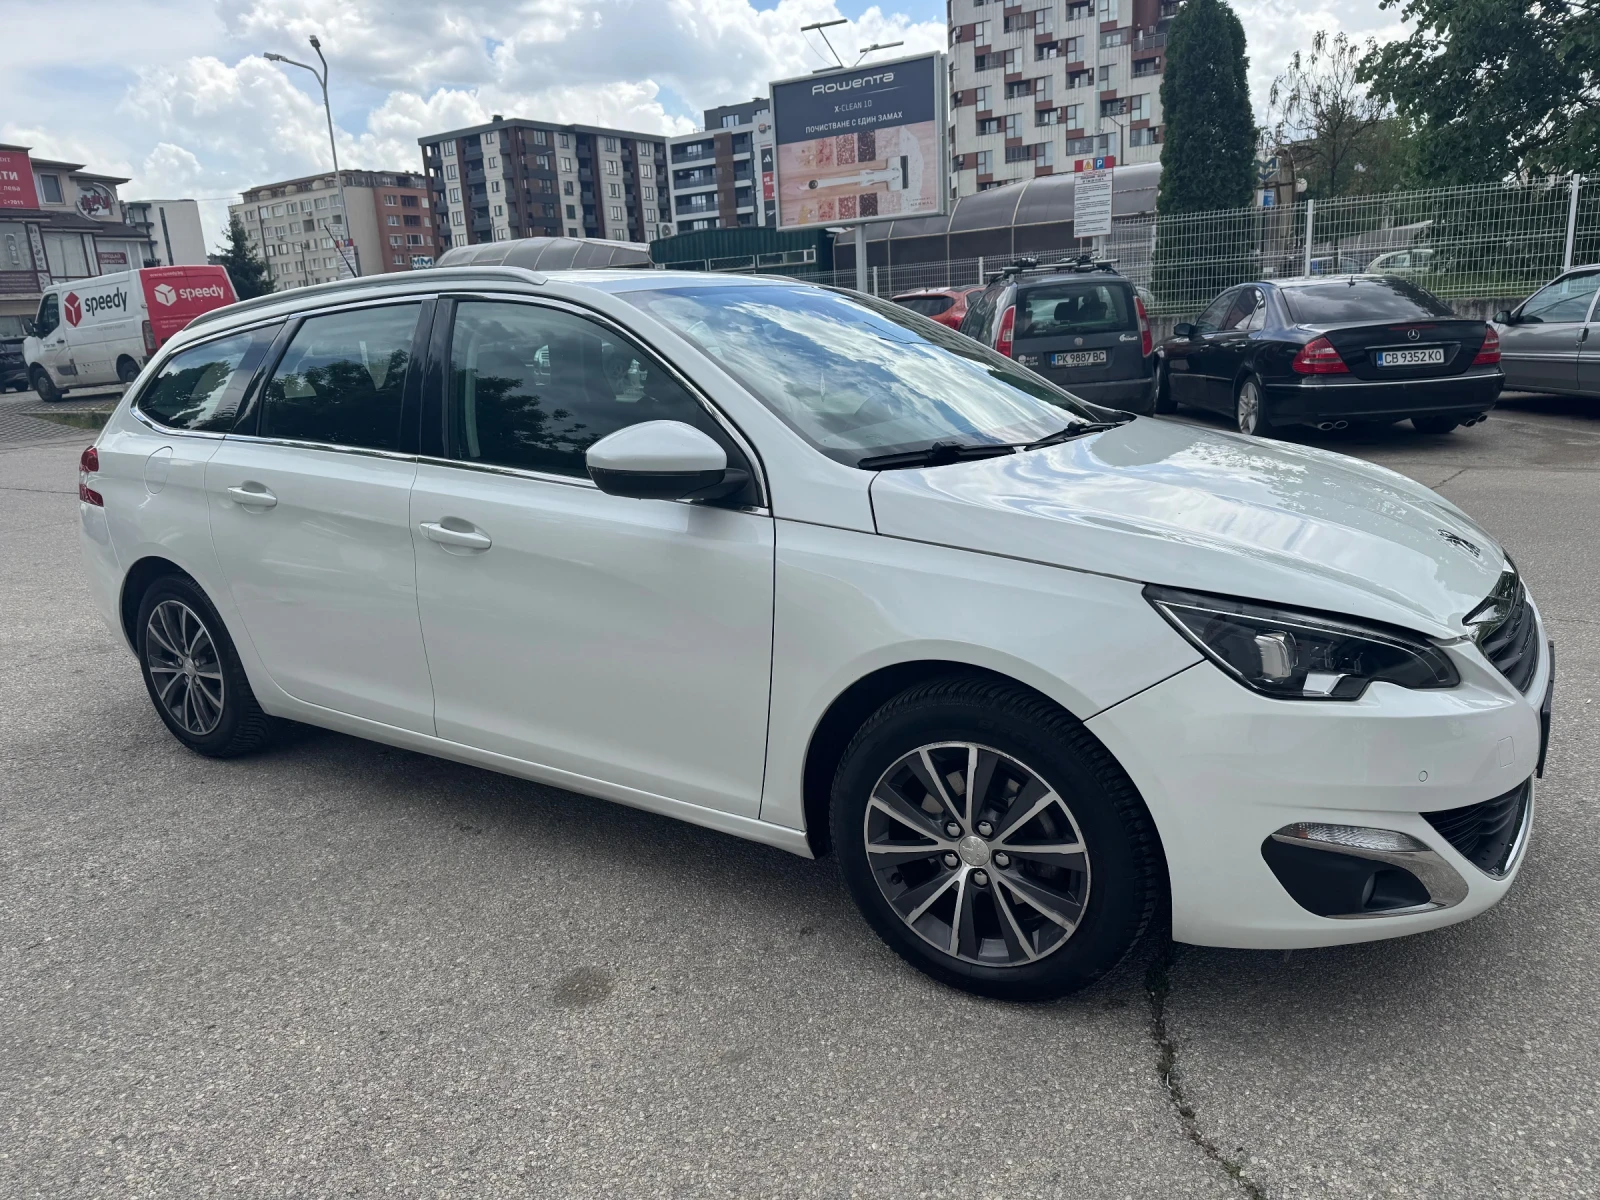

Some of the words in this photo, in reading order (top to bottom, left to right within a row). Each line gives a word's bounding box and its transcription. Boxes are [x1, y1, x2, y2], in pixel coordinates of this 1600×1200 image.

[811, 72, 895, 96] Rowenta
[834, 102, 862, 113] X-CLEAN
[863, 99, 873, 108] 10
[805, 119, 851, 134] ПОЧИСТВАНЕ
[857, 115, 877, 126] ЕДИН
[877, 111, 903, 122] ЗАМАХ
[0, 170, 19, 181] ТИ
[179, 283, 224, 302] speedy
[84, 286, 128, 317] speedy
[1056, 354, 1069, 365] PK
[1070, 352, 1092, 363] 9887
[1092, 351, 1105, 362] BC
[1384, 353, 1399, 364] CB
[1400, 351, 1427, 363] 9352
